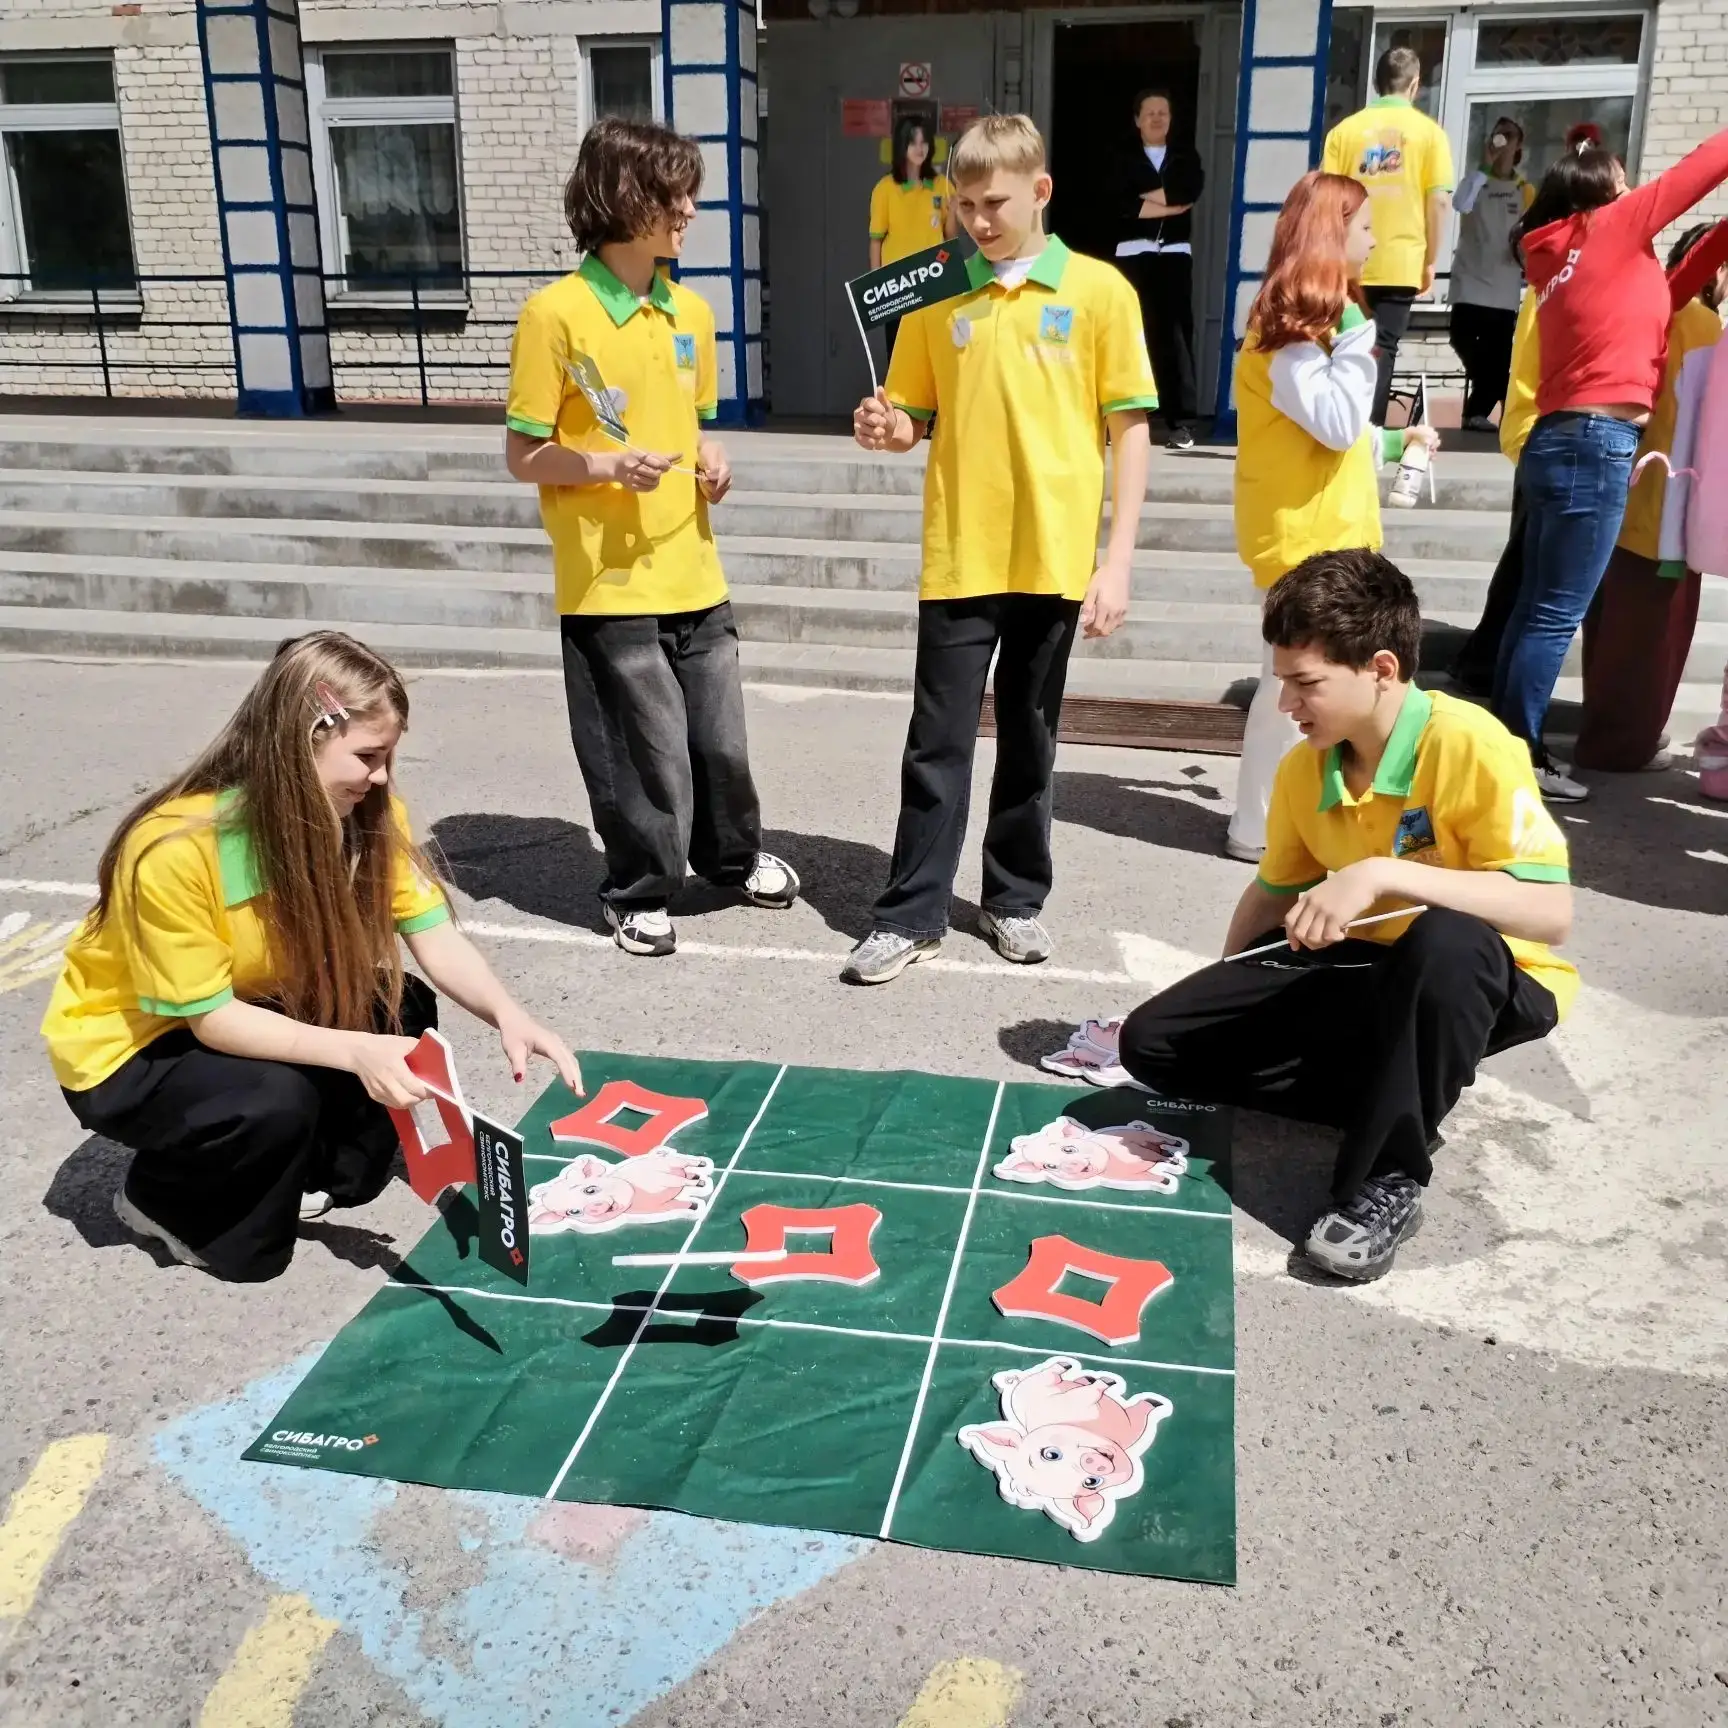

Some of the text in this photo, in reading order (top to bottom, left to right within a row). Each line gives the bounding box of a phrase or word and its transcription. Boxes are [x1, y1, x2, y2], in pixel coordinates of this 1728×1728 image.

[863, 262, 944, 304] СИБАГРО
[868, 292, 915, 316] БЕЛГОРОДСКИЙ
[1536, 265, 1573, 309] АГРО
[870, 297, 923, 322] СВИНОКОМПЛЕКС
[1146, 1100, 1217, 1112] СИБАГРО
[479, 1131, 489, 1201] СВИНОКОМПЛЕКС
[485, 1134, 495, 1196] БЕЛГОРОДСКИЙ
[495, 1141, 515, 1248] СИБАГРО
[272, 1430, 364, 1451] СИБАГРО
